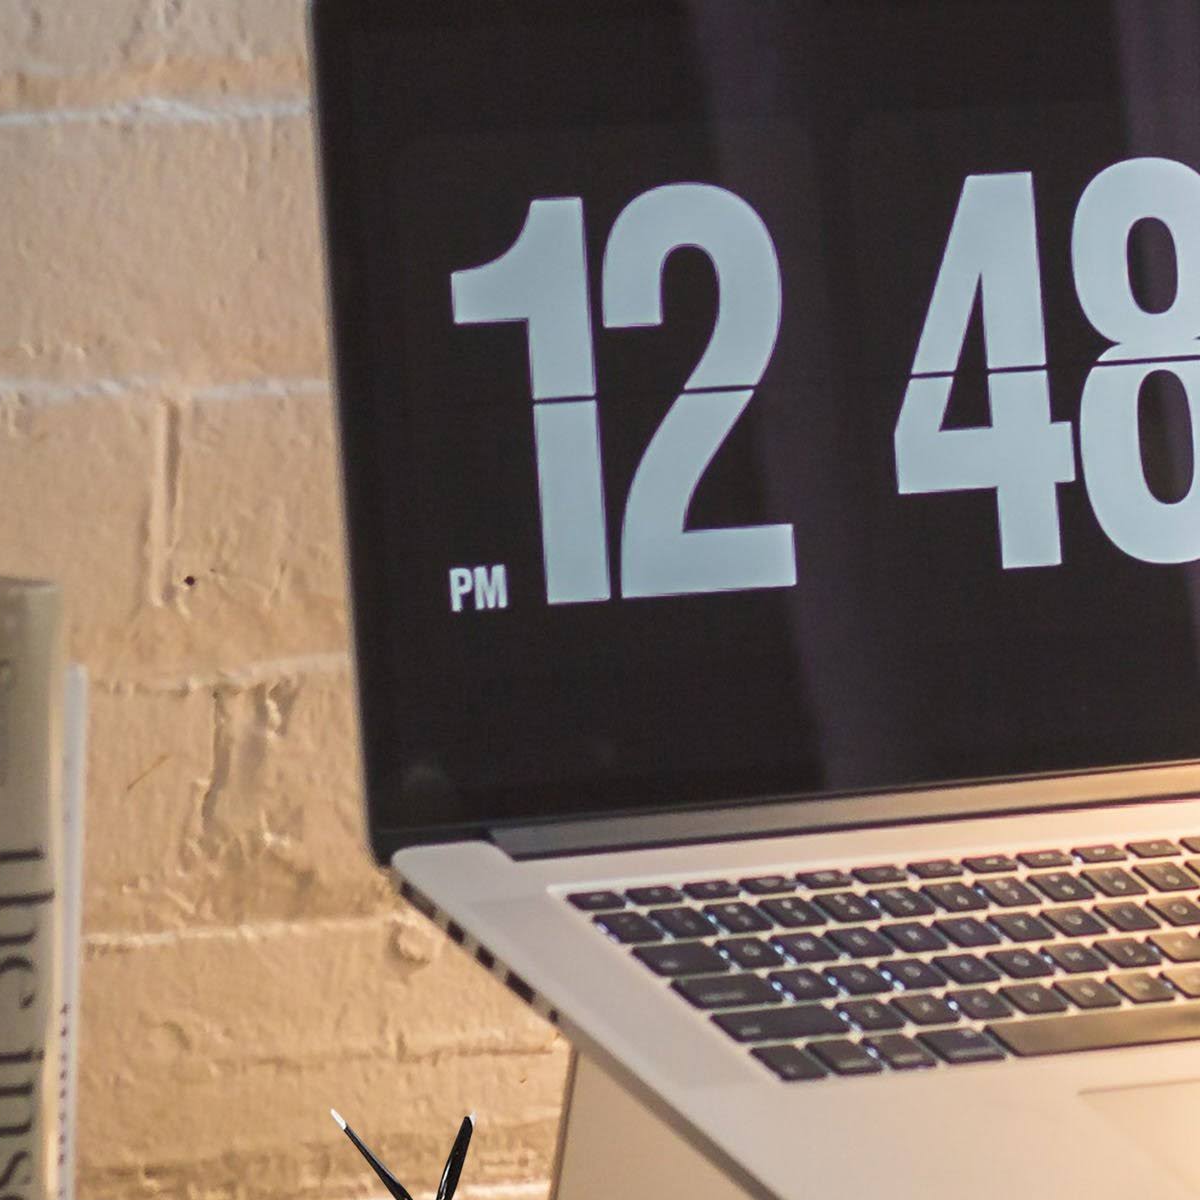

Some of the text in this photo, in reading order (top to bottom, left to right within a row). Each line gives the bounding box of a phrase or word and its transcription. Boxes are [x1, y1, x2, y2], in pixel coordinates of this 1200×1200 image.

[450, 156, 1200, 604] 12 48
[449, 564, 508, 612] PM
